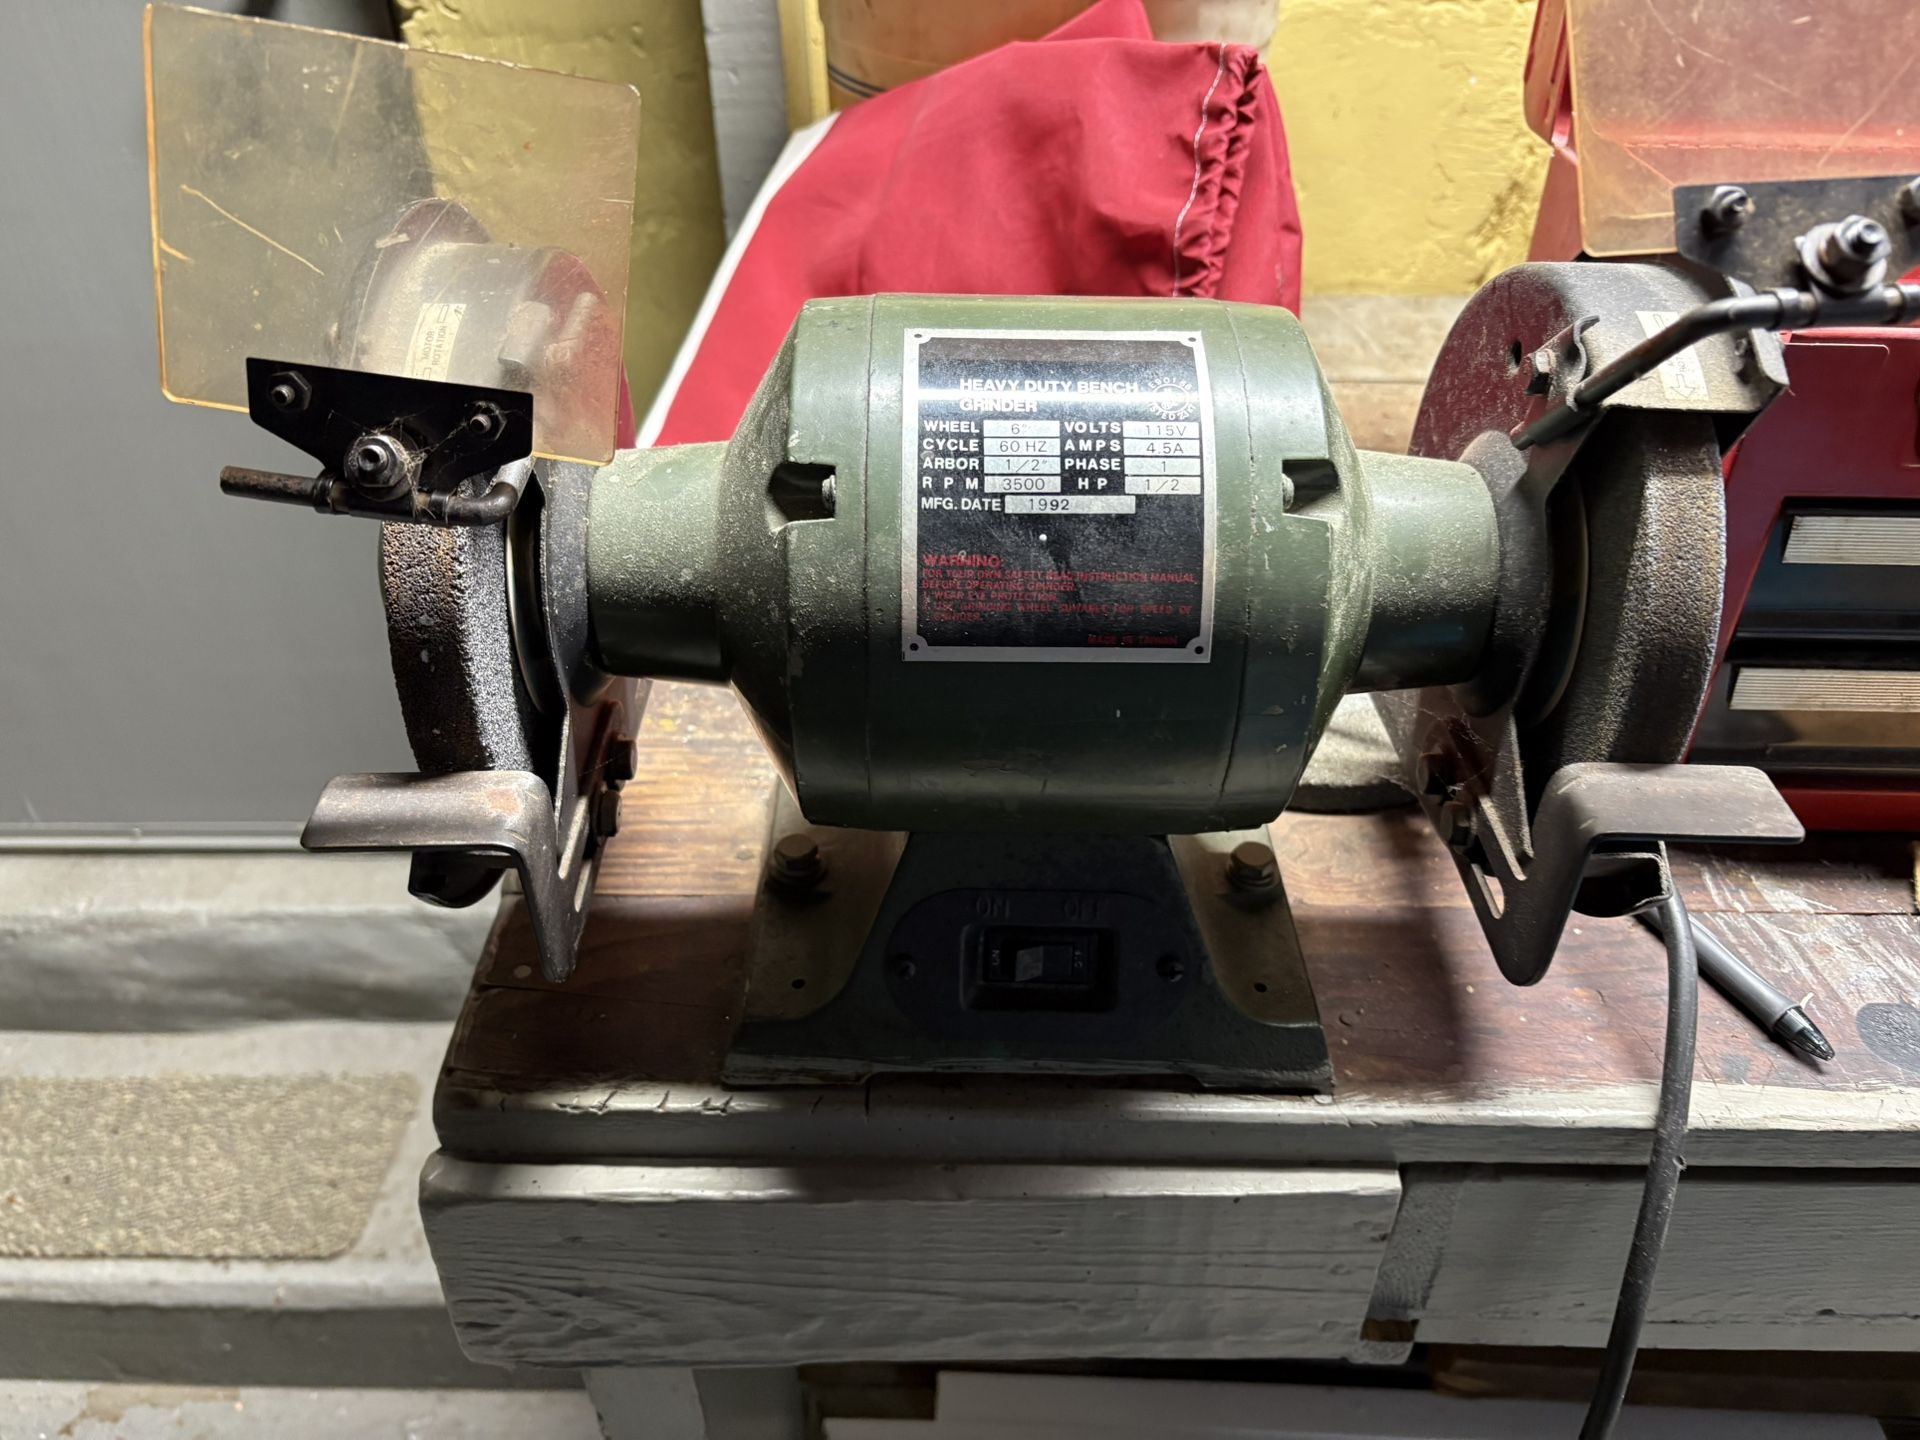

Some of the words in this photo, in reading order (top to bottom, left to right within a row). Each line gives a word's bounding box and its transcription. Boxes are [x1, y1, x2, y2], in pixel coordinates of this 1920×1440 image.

[959, 378, 1020, 392] HEAVY
[1024, 380, 1072, 393] DUTY
[1077, 381, 1139, 394] BENCH
[959, 398, 1038, 412] GRINDER
[924, 420, 980, 433] WHEEL
[1064, 421, 1121, 433] VOLTS
[1145, 425, 1187, 437] 115V
[922, 438, 979, 451] CYCLE
[999, 440, 1021, 453] 60
[1025, 440, 1048, 453] HZ
[1064, 439, 1121, 452] AMPS
[1146, 442, 1184, 454] 4.5A
[922, 457, 980, 470] ARBOR
[1064, 458, 1121, 471] PHASE
[1161, 461, 1167, 473] 1
[1002, 478, 1046, 491] 3500
[1145, 479, 1180, 492] 1/2
[920, 496, 958, 510] MFG.
[961, 498, 1002, 511] DATE
[1028, 498, 1070, 511] 1992
[922, 567, 943, 578] FOR
[1076, 571, 1149, 583] INSTRUCTION
[922, 579, 961, 589] BEFORE
[965, 580, 1025, 591] OPERATING
[976, 895, 1011, 919] ON
